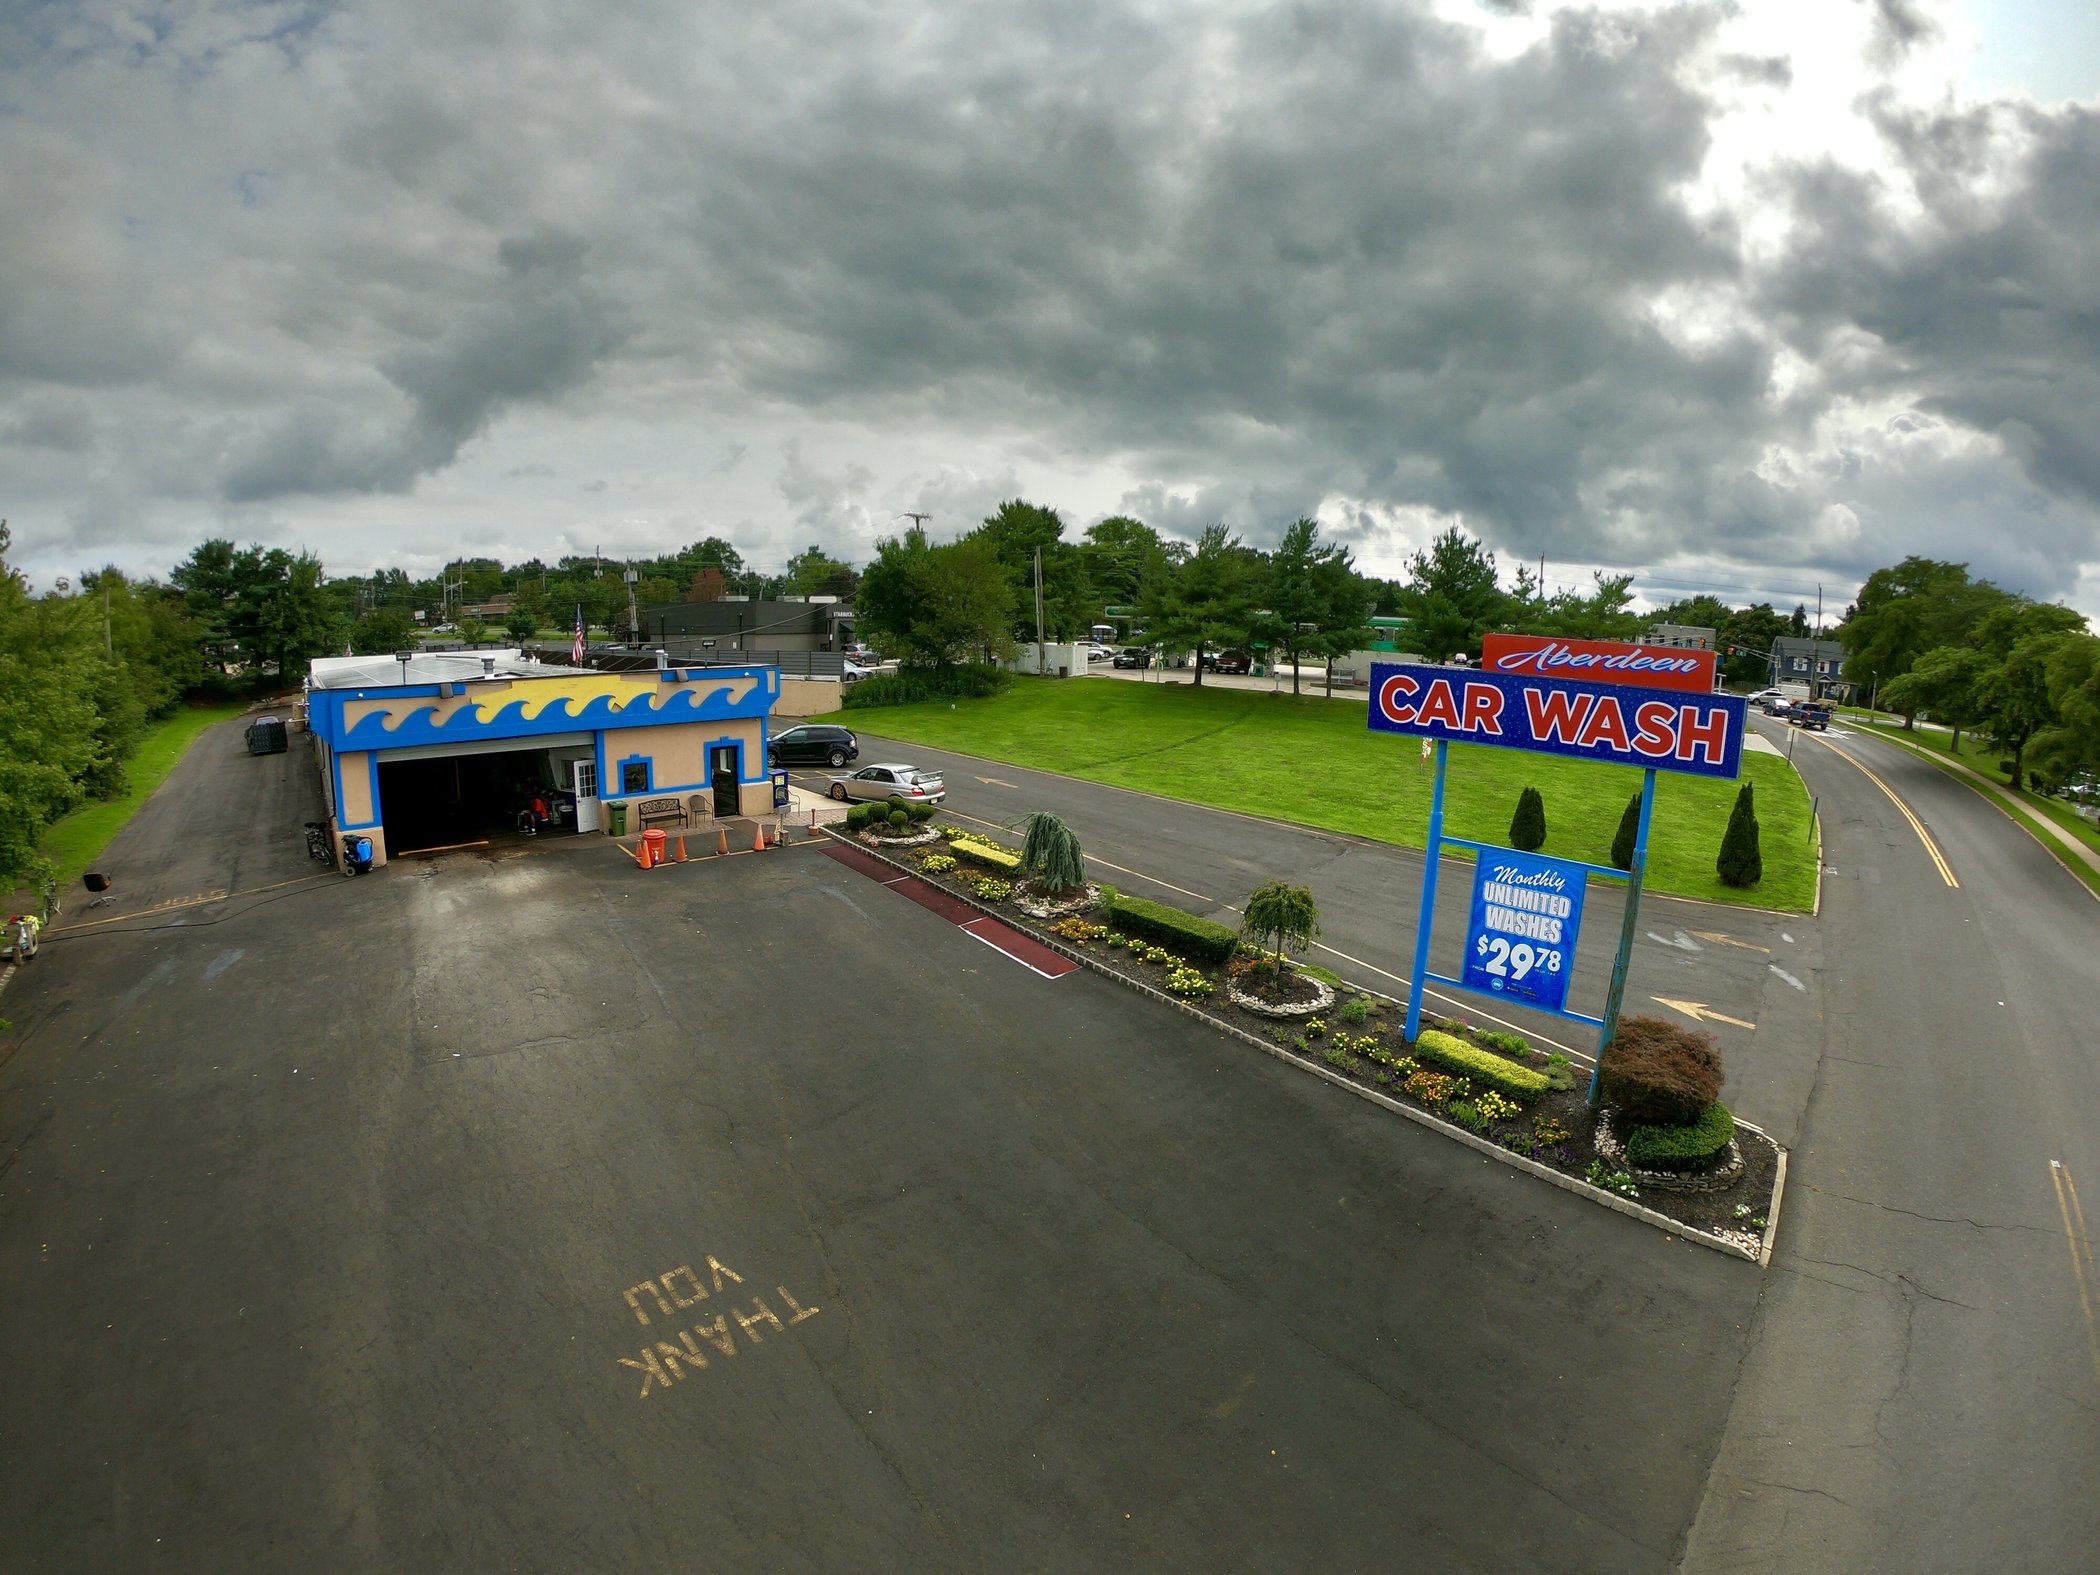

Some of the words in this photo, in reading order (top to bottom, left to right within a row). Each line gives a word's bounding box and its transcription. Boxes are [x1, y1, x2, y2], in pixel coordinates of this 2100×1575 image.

[1497, 642, 1701, 674] Aberdeen
[1379, 675, 1504, 736] CAR
[1523, 687, 1729, 765] WASH
[1493, 865, 1567, 893] Monthly
[1483, 881, 1571, 919] UNLIMITED
[1485, 905, 1563, 944] WASHES
[622, 1254, 746, 1326] YOU
[616, 1284, 822, 1399] THANK
